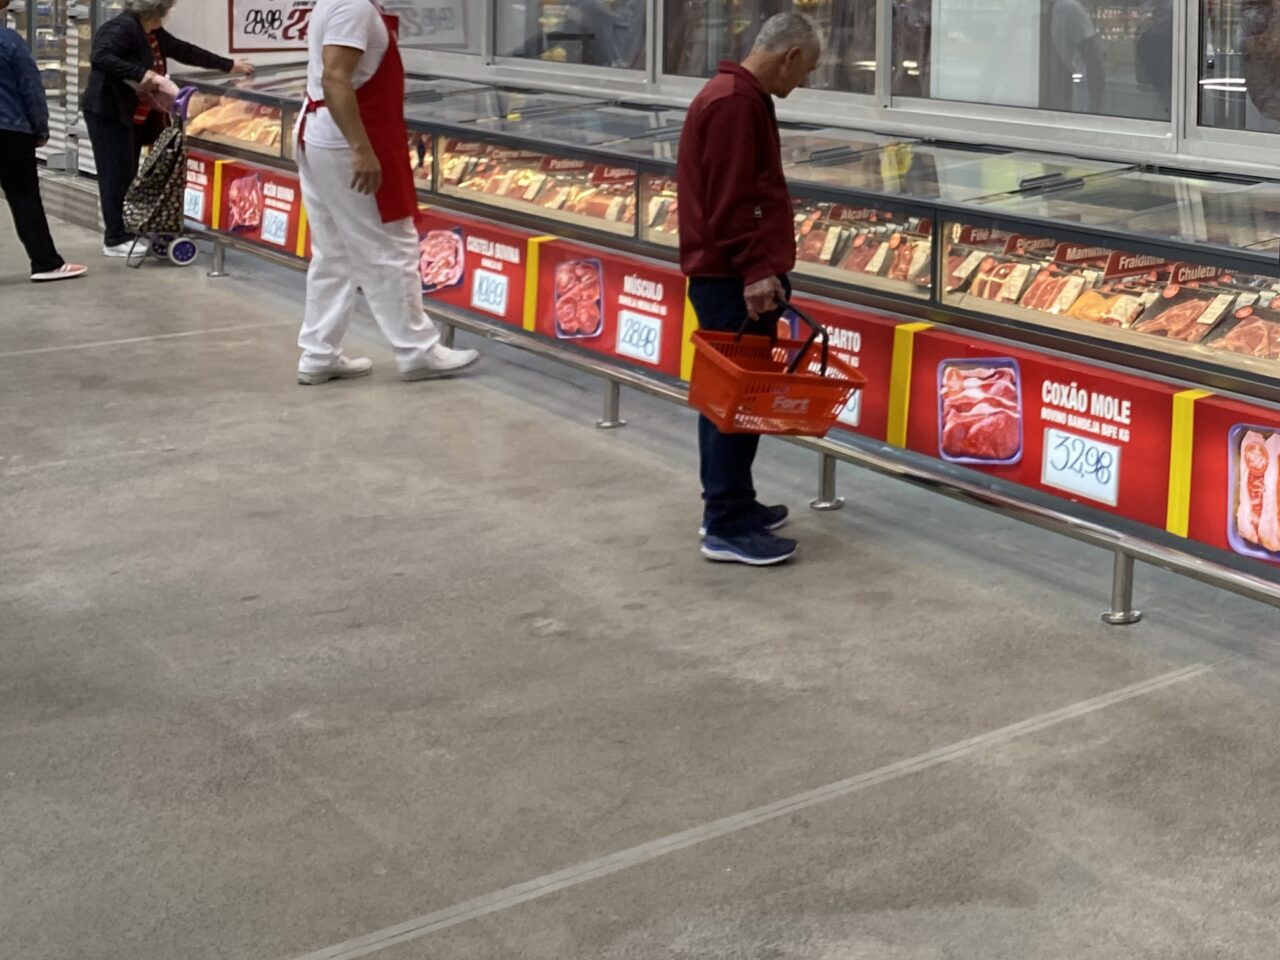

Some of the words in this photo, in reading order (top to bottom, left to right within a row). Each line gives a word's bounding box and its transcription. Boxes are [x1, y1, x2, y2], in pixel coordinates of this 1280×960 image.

[623, 273, 664, 302] MÚSCULO
[1178, 265, 1216, 282] Chuleta
[1042, 380, 1088, 413] COXÃO
[1090, 392, 1131, 425] MOLE
[1050, 433, 1113, 485] 32,98
